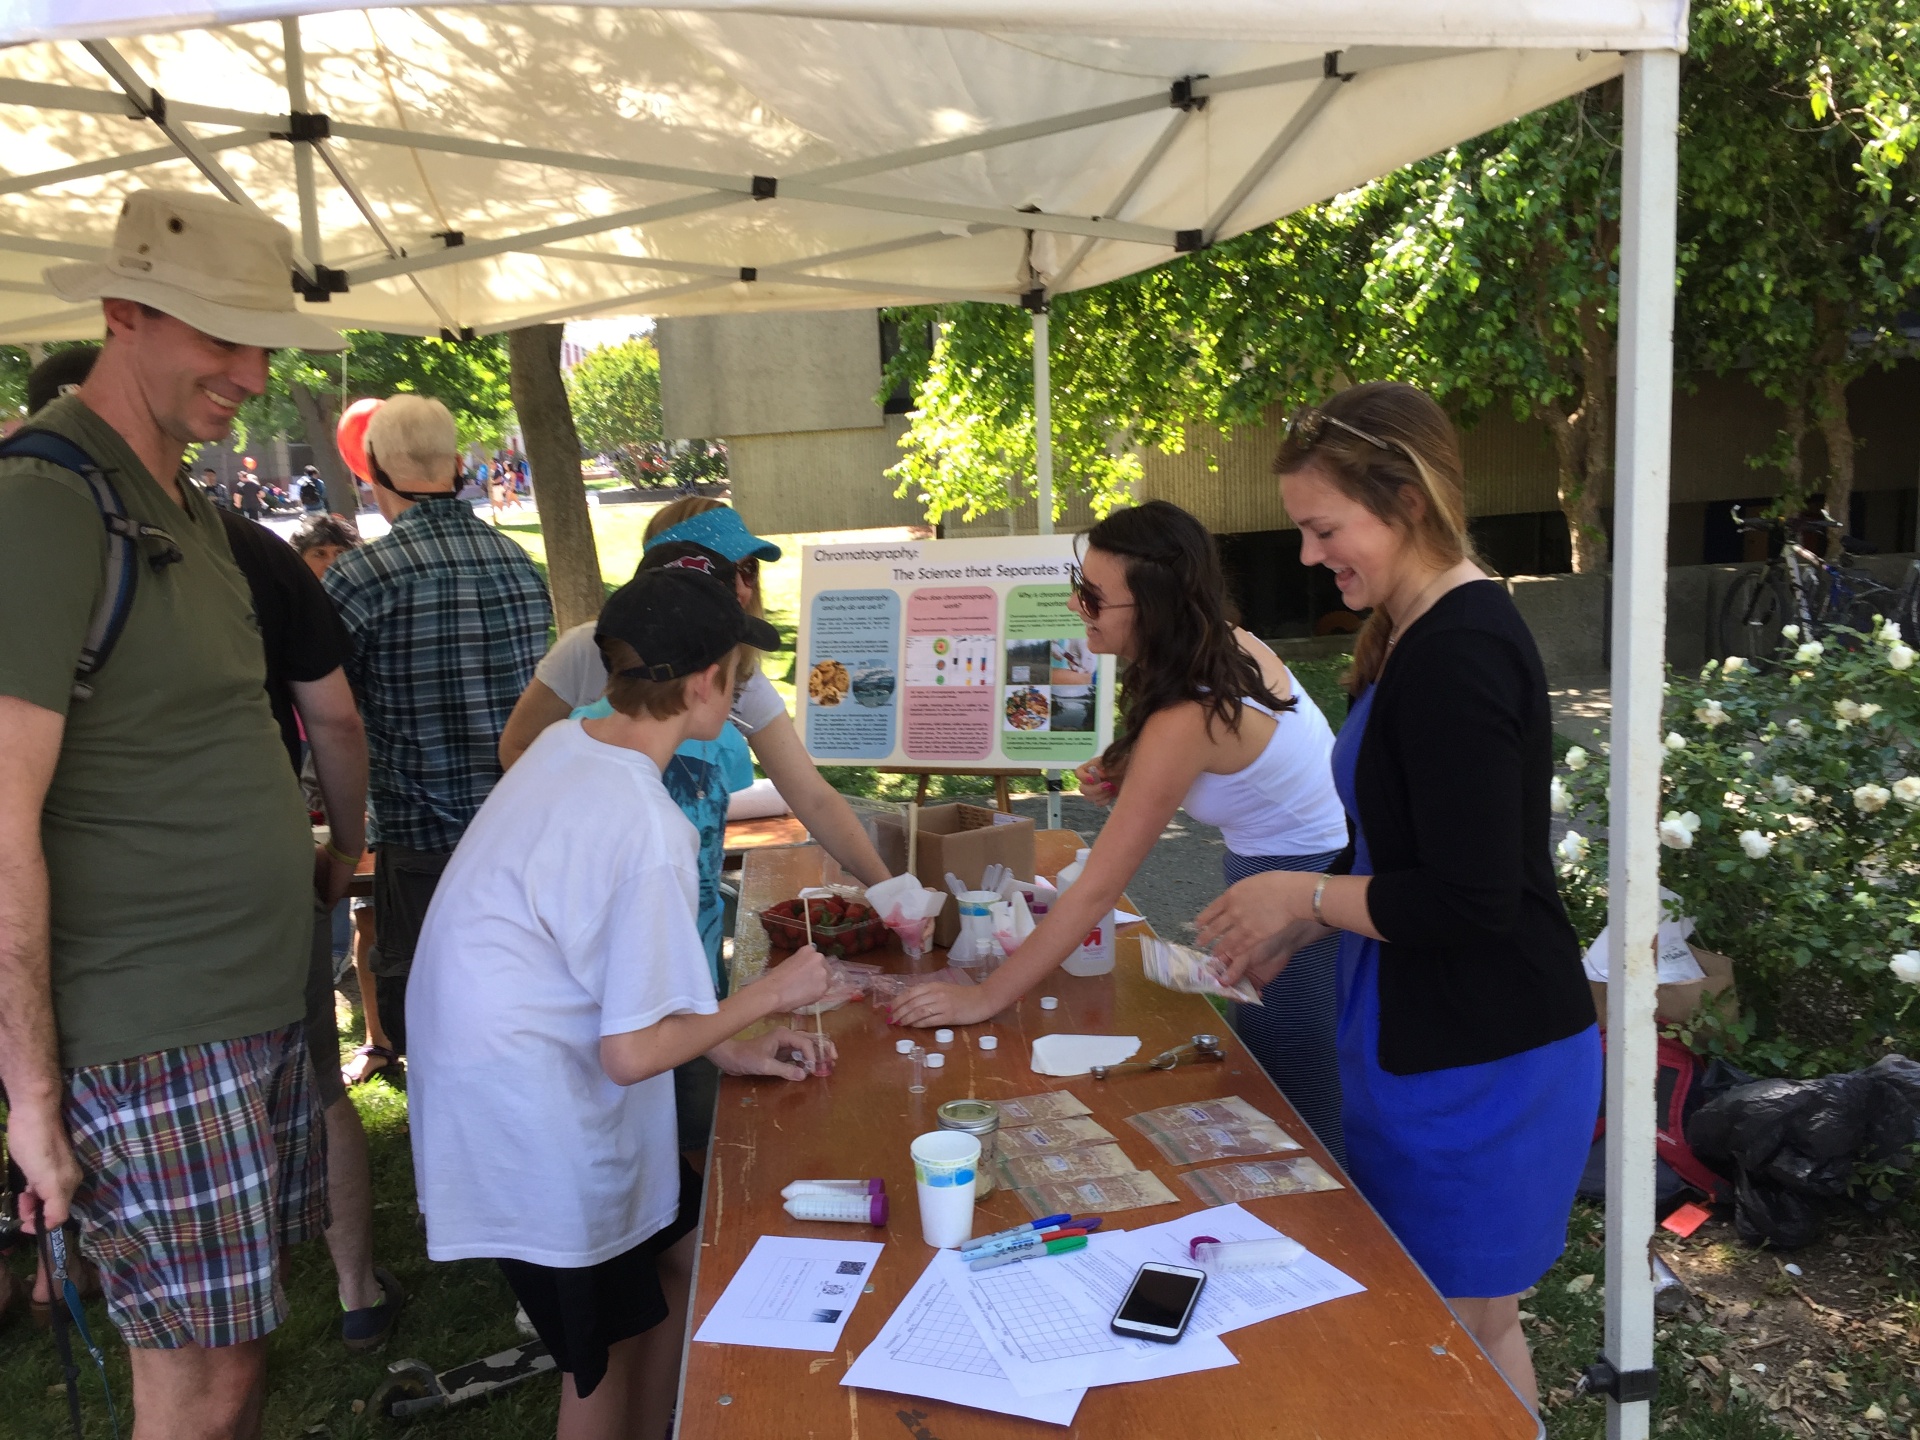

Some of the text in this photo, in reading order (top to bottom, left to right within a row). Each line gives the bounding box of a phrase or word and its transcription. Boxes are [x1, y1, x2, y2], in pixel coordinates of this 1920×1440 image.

[813, 546, 919, 562] Chromatography:
[892, 568, 915, 581] The
[917, 565, 963, 580] Science
[966, 564, 992, 578] that
[996, 563, 1060, 579] Separates
